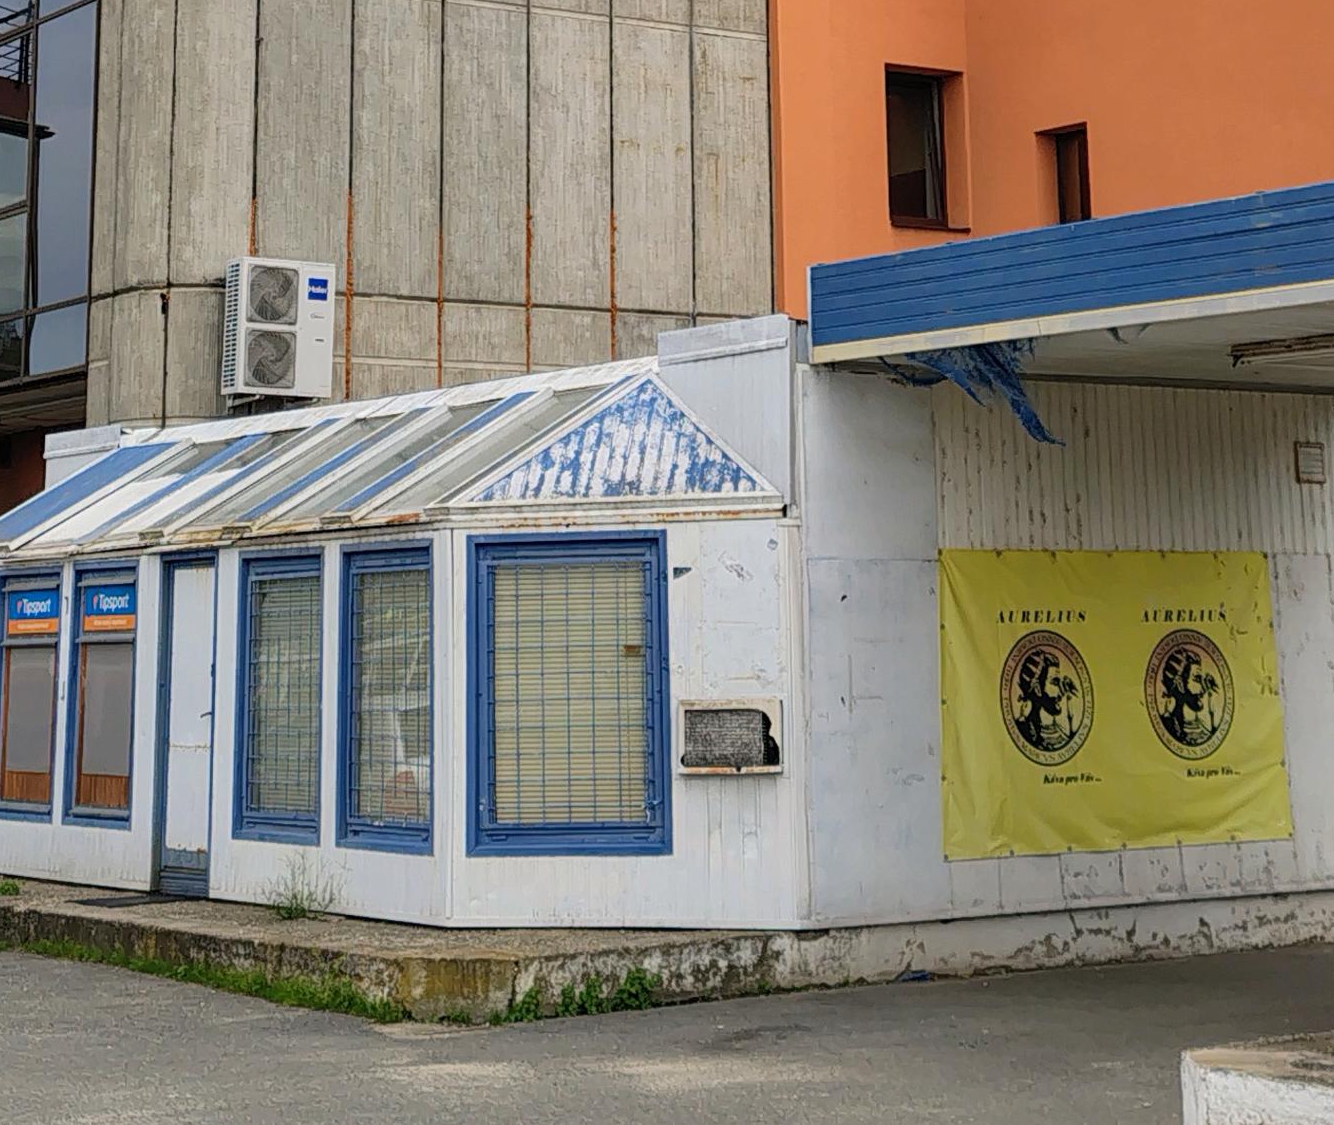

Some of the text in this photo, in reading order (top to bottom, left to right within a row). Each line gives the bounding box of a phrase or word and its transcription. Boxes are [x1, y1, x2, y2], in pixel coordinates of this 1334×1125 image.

[22, 597, 52, 616] Tipsport
[99, 593, 129, 612] Tipsport
[996, 610, 1086, 623] AURELIUS
[1141, 609, 1228, 622] AURELIUS
